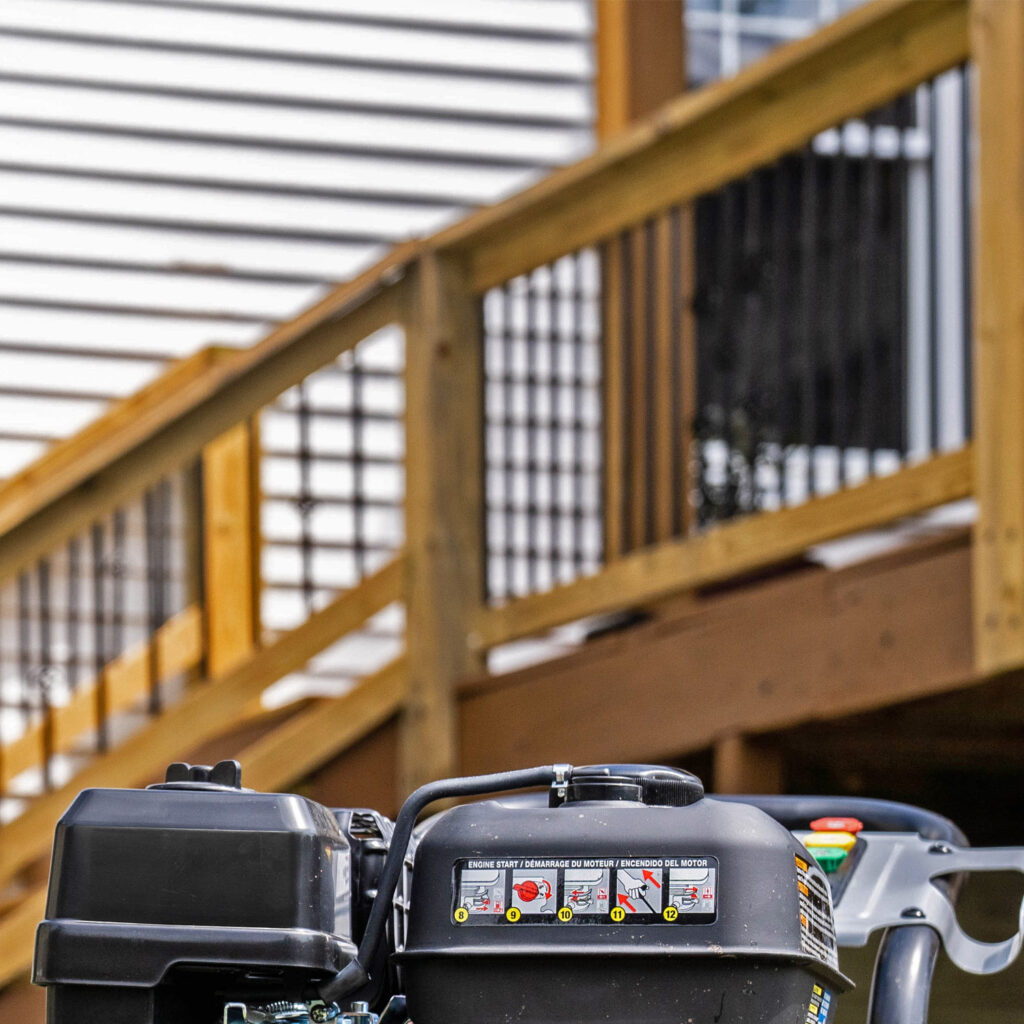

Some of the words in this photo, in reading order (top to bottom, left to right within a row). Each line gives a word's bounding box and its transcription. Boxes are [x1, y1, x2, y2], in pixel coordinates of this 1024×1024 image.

[468, 860, 495, 869] ENGINE
[496, 860, 519, 868] START
[525, 859, 570, 868] DÉMARRAGE
[458, 911, 464, 920] 8
[510, 910, 517, 920] 9
[560, 910, 571, 920] 10
[613, 910, 622, 919] 11
[666, 910, 676, 919] 12
